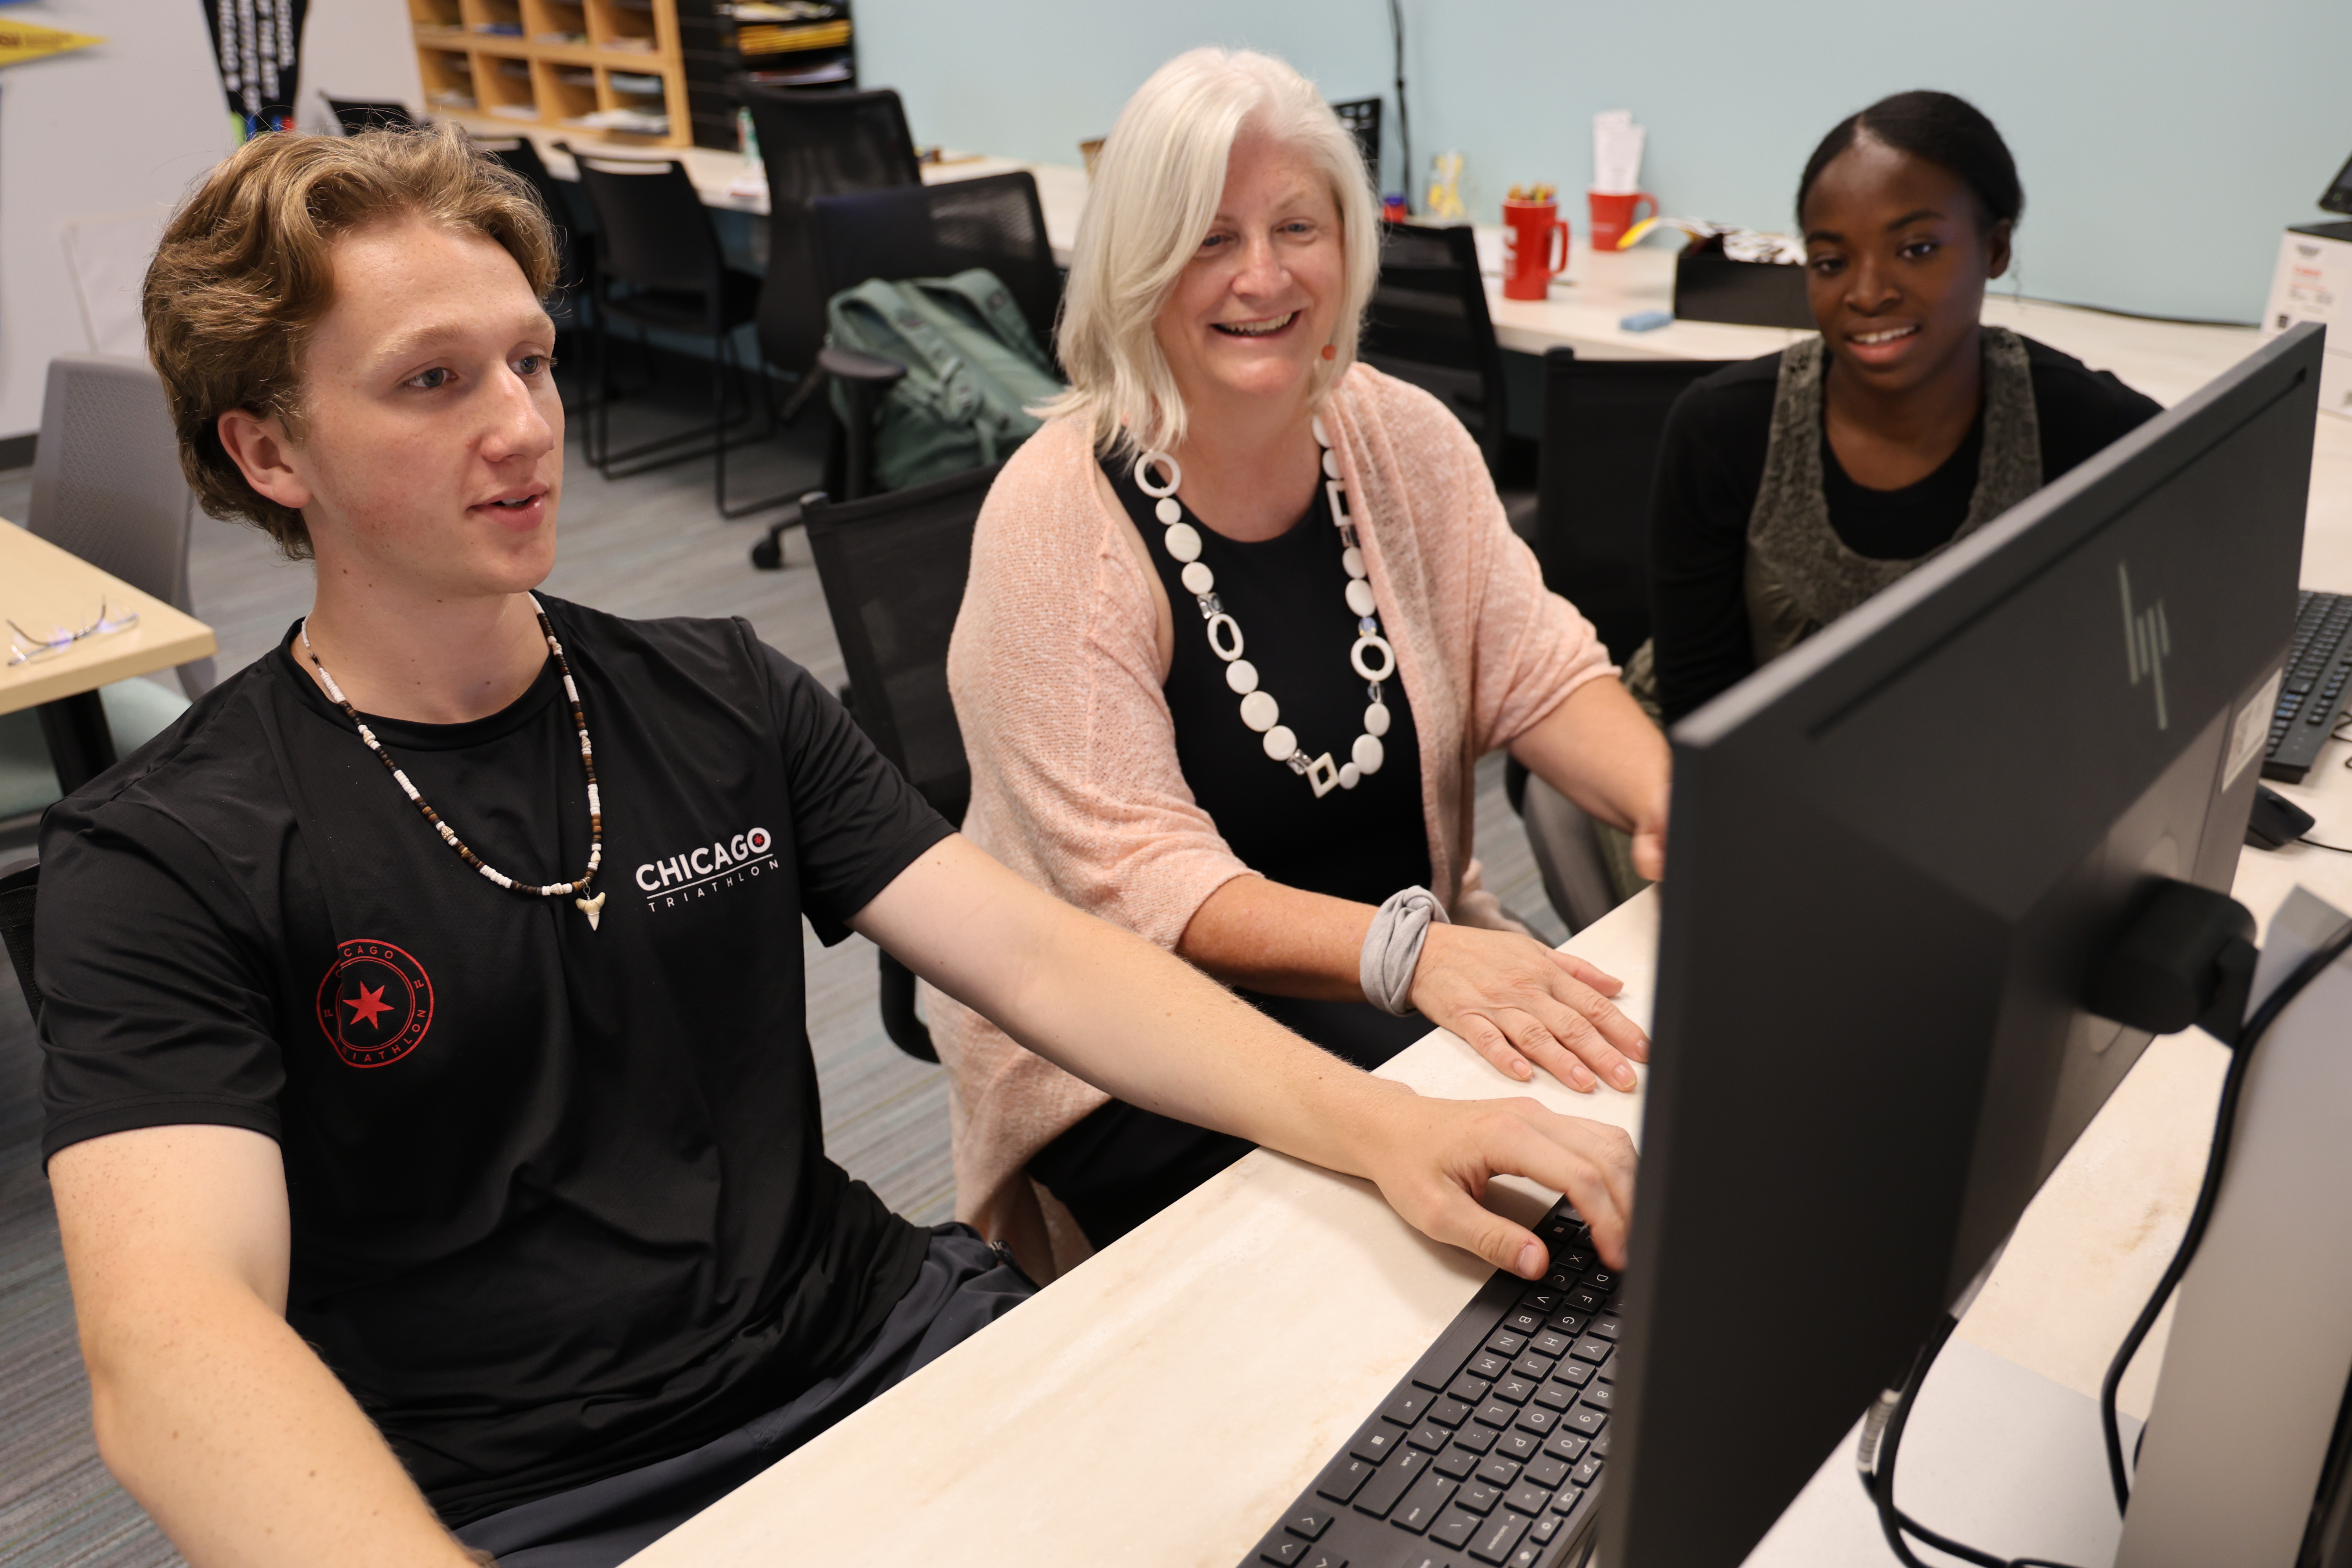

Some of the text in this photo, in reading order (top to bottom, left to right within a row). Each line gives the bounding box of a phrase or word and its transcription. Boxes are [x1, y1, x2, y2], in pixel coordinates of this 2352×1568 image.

[636, 827, 771, 891] CHICAGO
[648, 859, 779, 913] TRIATHLON
[1499, 1337, 1514, 1346] N
[1544, 1337, 1559, 1346] H
[1481, 1359, 1496, 1369] M
[1568, 1367, 1582, 1376] U
[1507, 1382, 1522, 1392] K
[1531, 1414, 1544, 1423] O
[1515, 1437, 1526, 1447] P
